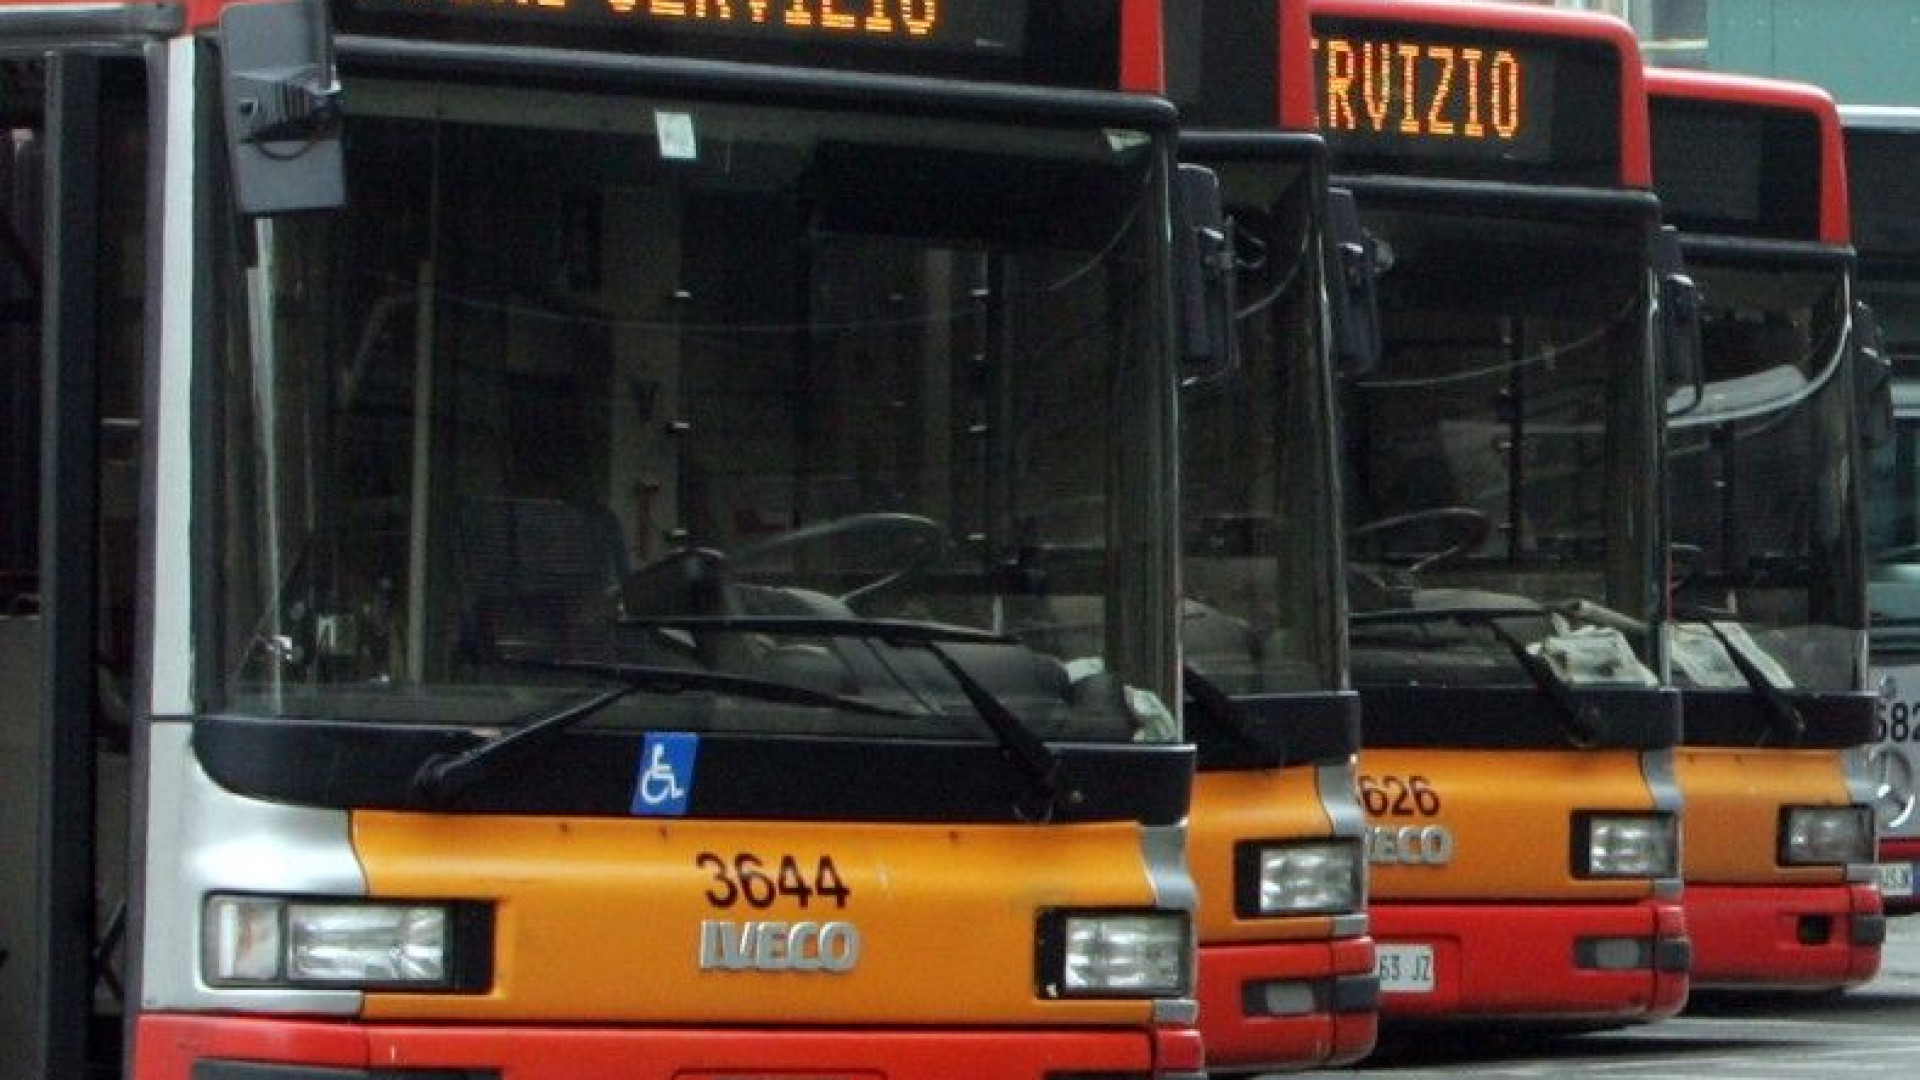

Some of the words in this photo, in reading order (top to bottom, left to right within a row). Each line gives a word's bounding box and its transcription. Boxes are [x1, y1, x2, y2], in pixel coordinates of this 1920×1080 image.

[1312, 38, 1519, 138] RVIZIO
[1357, 775, 1441, 817] 626
[696, 852, 850, 909] 3644
[700, 920, 860, 971] IVECO
